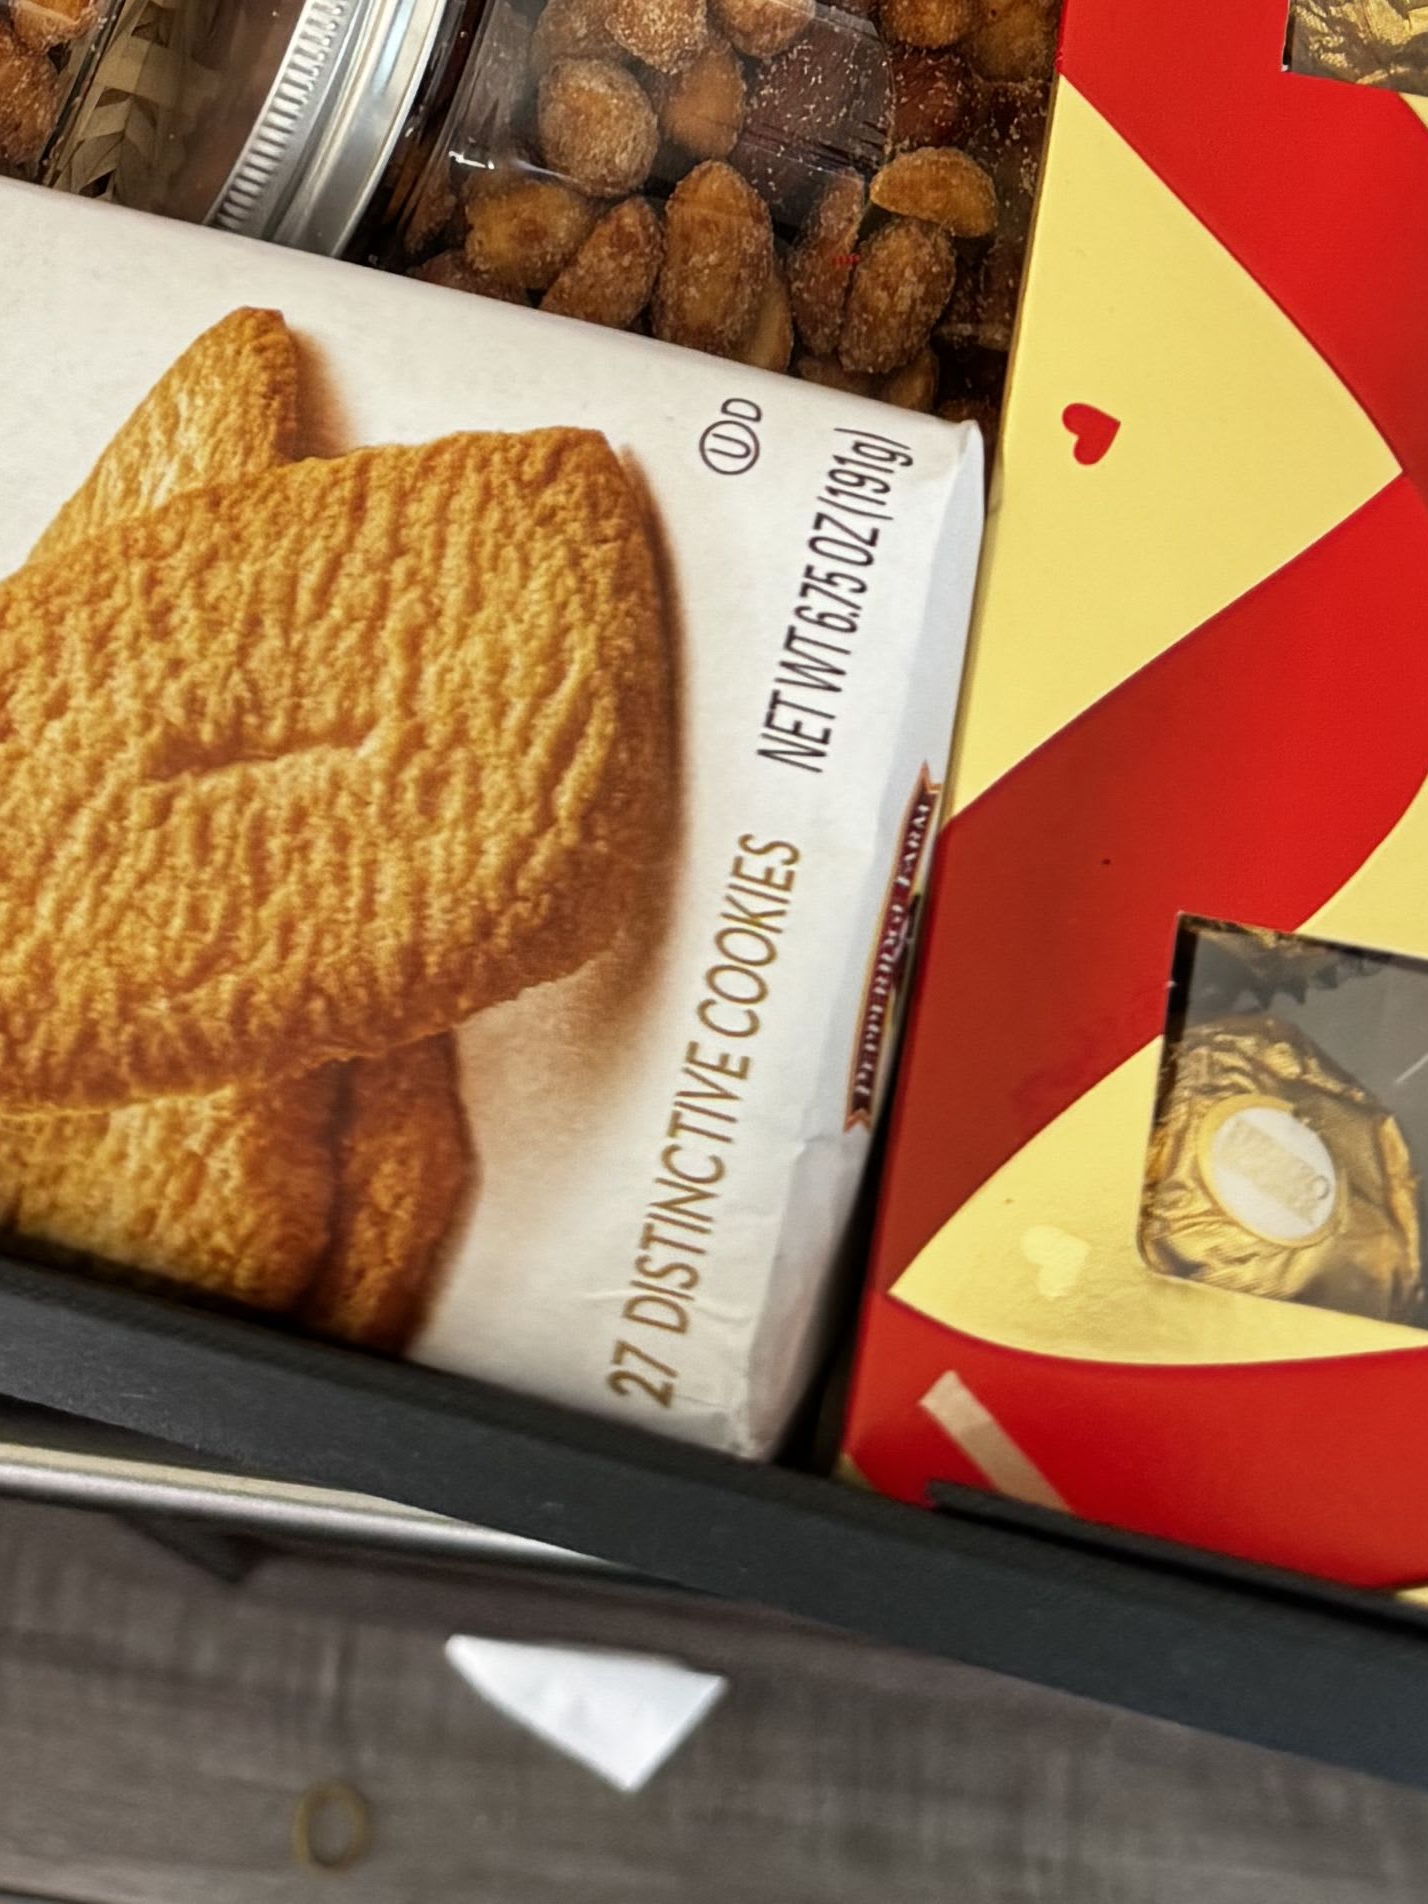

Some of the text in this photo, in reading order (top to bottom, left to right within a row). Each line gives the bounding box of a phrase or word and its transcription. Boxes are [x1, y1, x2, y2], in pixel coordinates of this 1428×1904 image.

[757, 427, 914, 773] NET WT 6.75 OZ (191g)
[607, 833, 801, 1409] 27 DISTINCTIVE COOKIES
